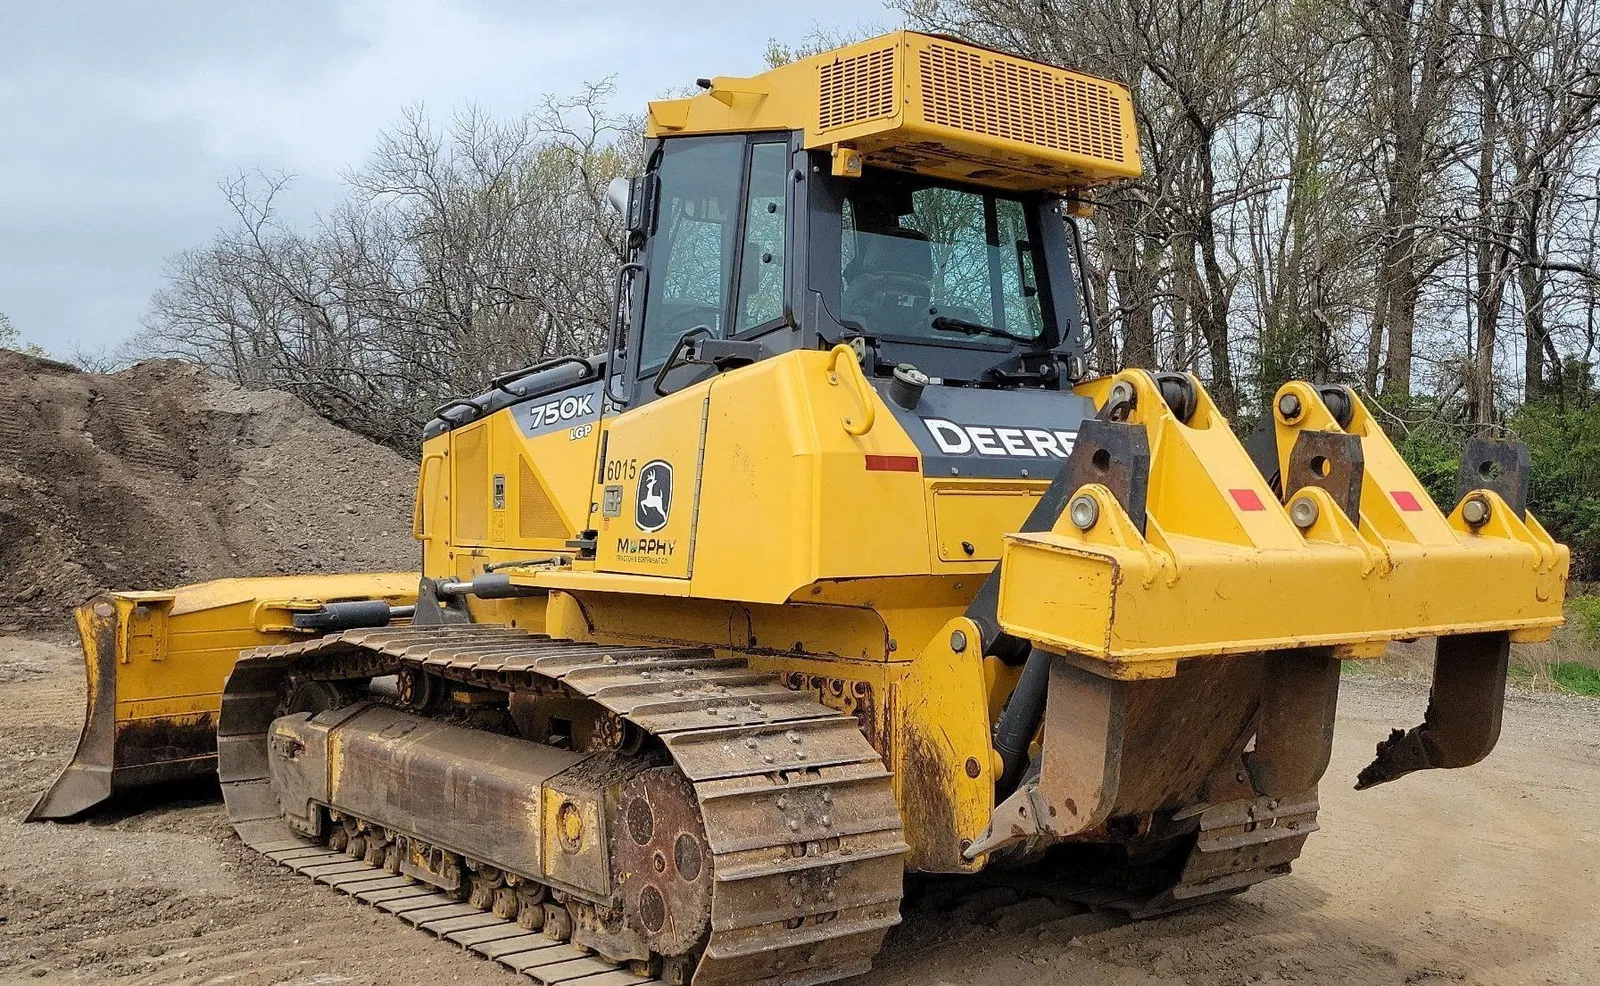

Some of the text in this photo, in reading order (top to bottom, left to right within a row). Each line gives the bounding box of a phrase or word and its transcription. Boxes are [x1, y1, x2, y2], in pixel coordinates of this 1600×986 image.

[530, 393, 595, 429] 750K
[569, 425, 592, 440] LGP
[607, 459, 637, 481] 6015
